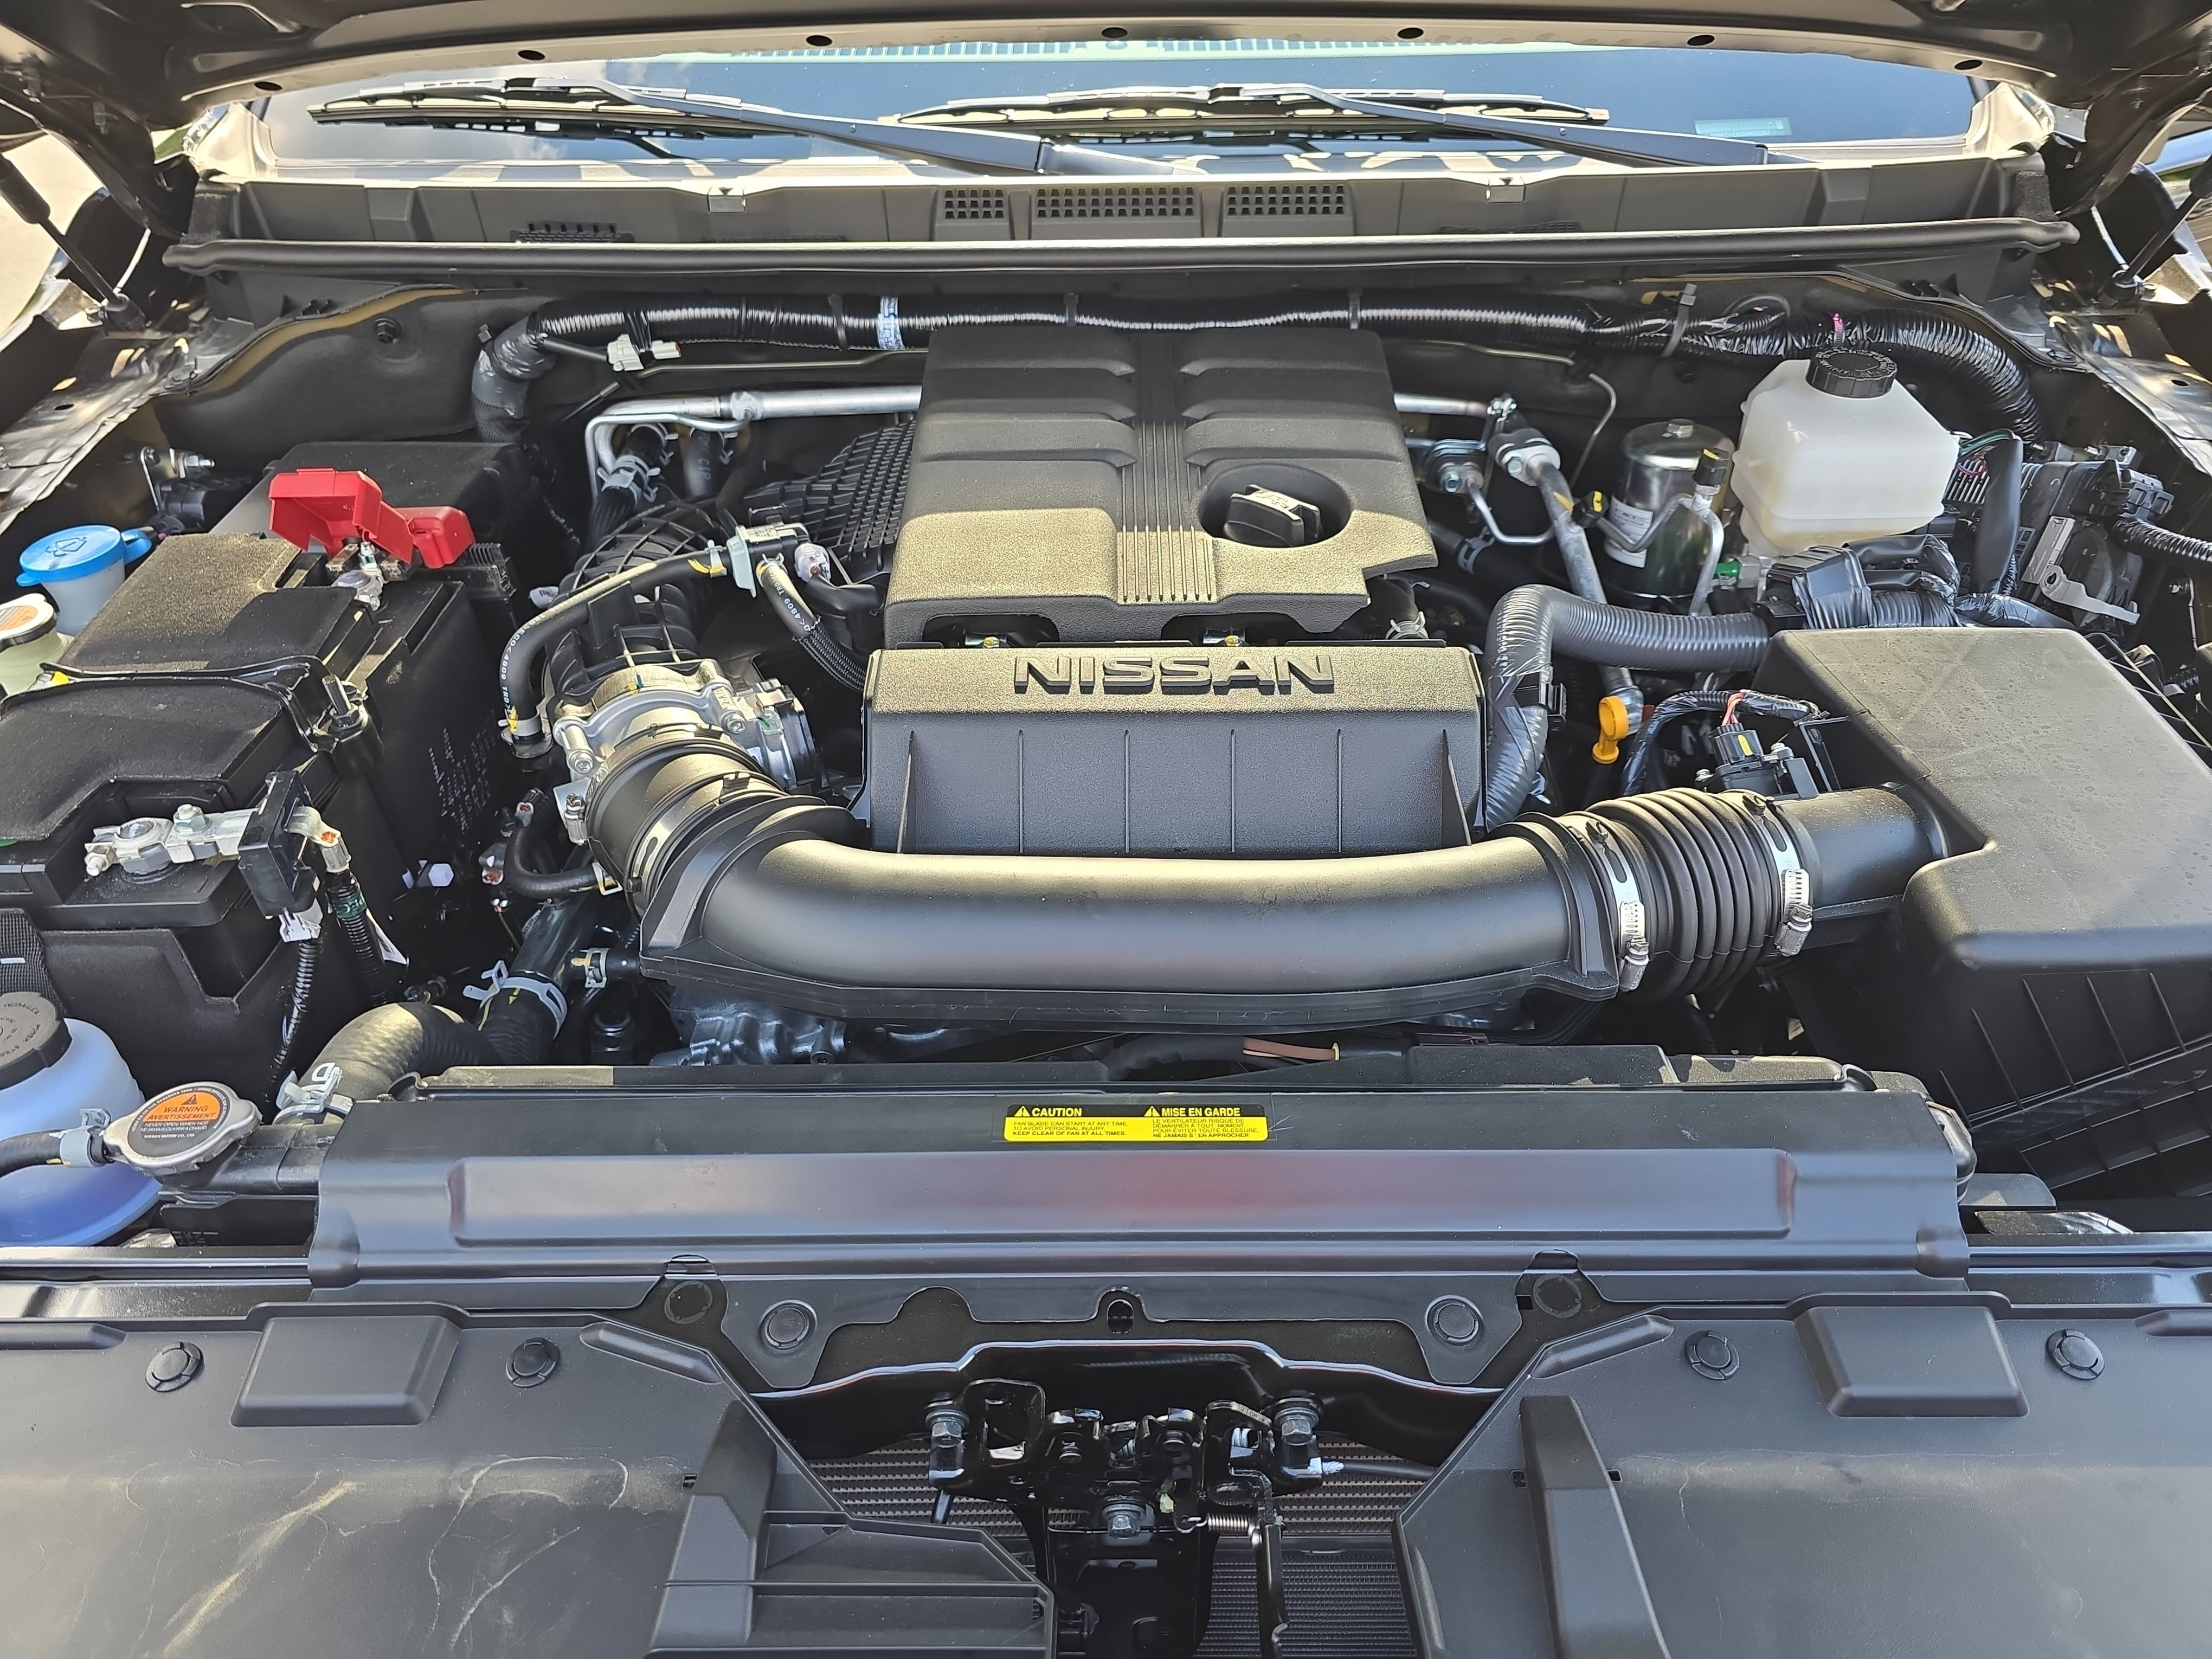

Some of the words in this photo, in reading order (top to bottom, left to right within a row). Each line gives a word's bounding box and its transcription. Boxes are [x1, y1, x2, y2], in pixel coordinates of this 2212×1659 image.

[1013, 654, 1335, 693] NISSAN
[1032, 1108, 1082, 1117] CAUTION
[1162, 1108, 1186, 1117] MISE
[1188, 1108, 1203, 1117] EN
[1205, 1108, 1240, 1117] GARDE
